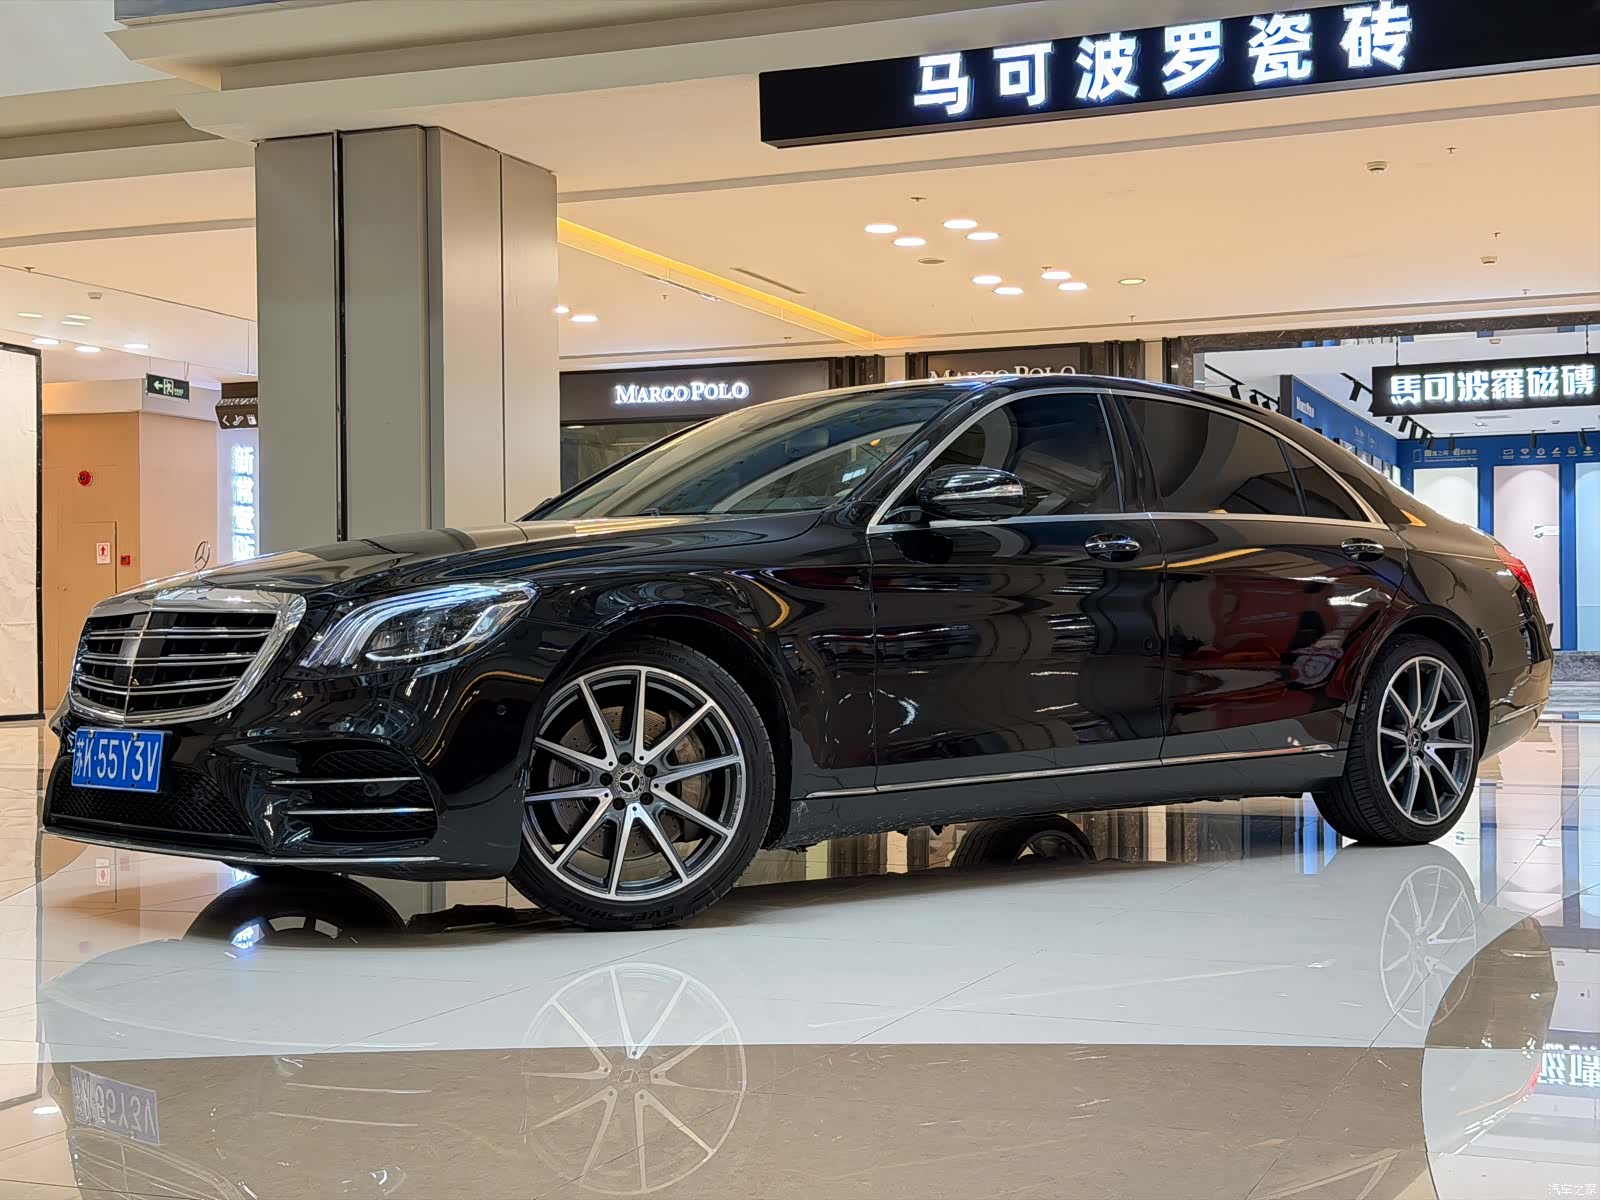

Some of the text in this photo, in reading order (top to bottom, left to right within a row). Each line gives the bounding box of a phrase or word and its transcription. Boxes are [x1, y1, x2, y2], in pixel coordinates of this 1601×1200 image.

[914, 1, 1412, 114] 马可波罗瓷砖
[1390, 364, 1597, 404] 馬可波羅磁磚
